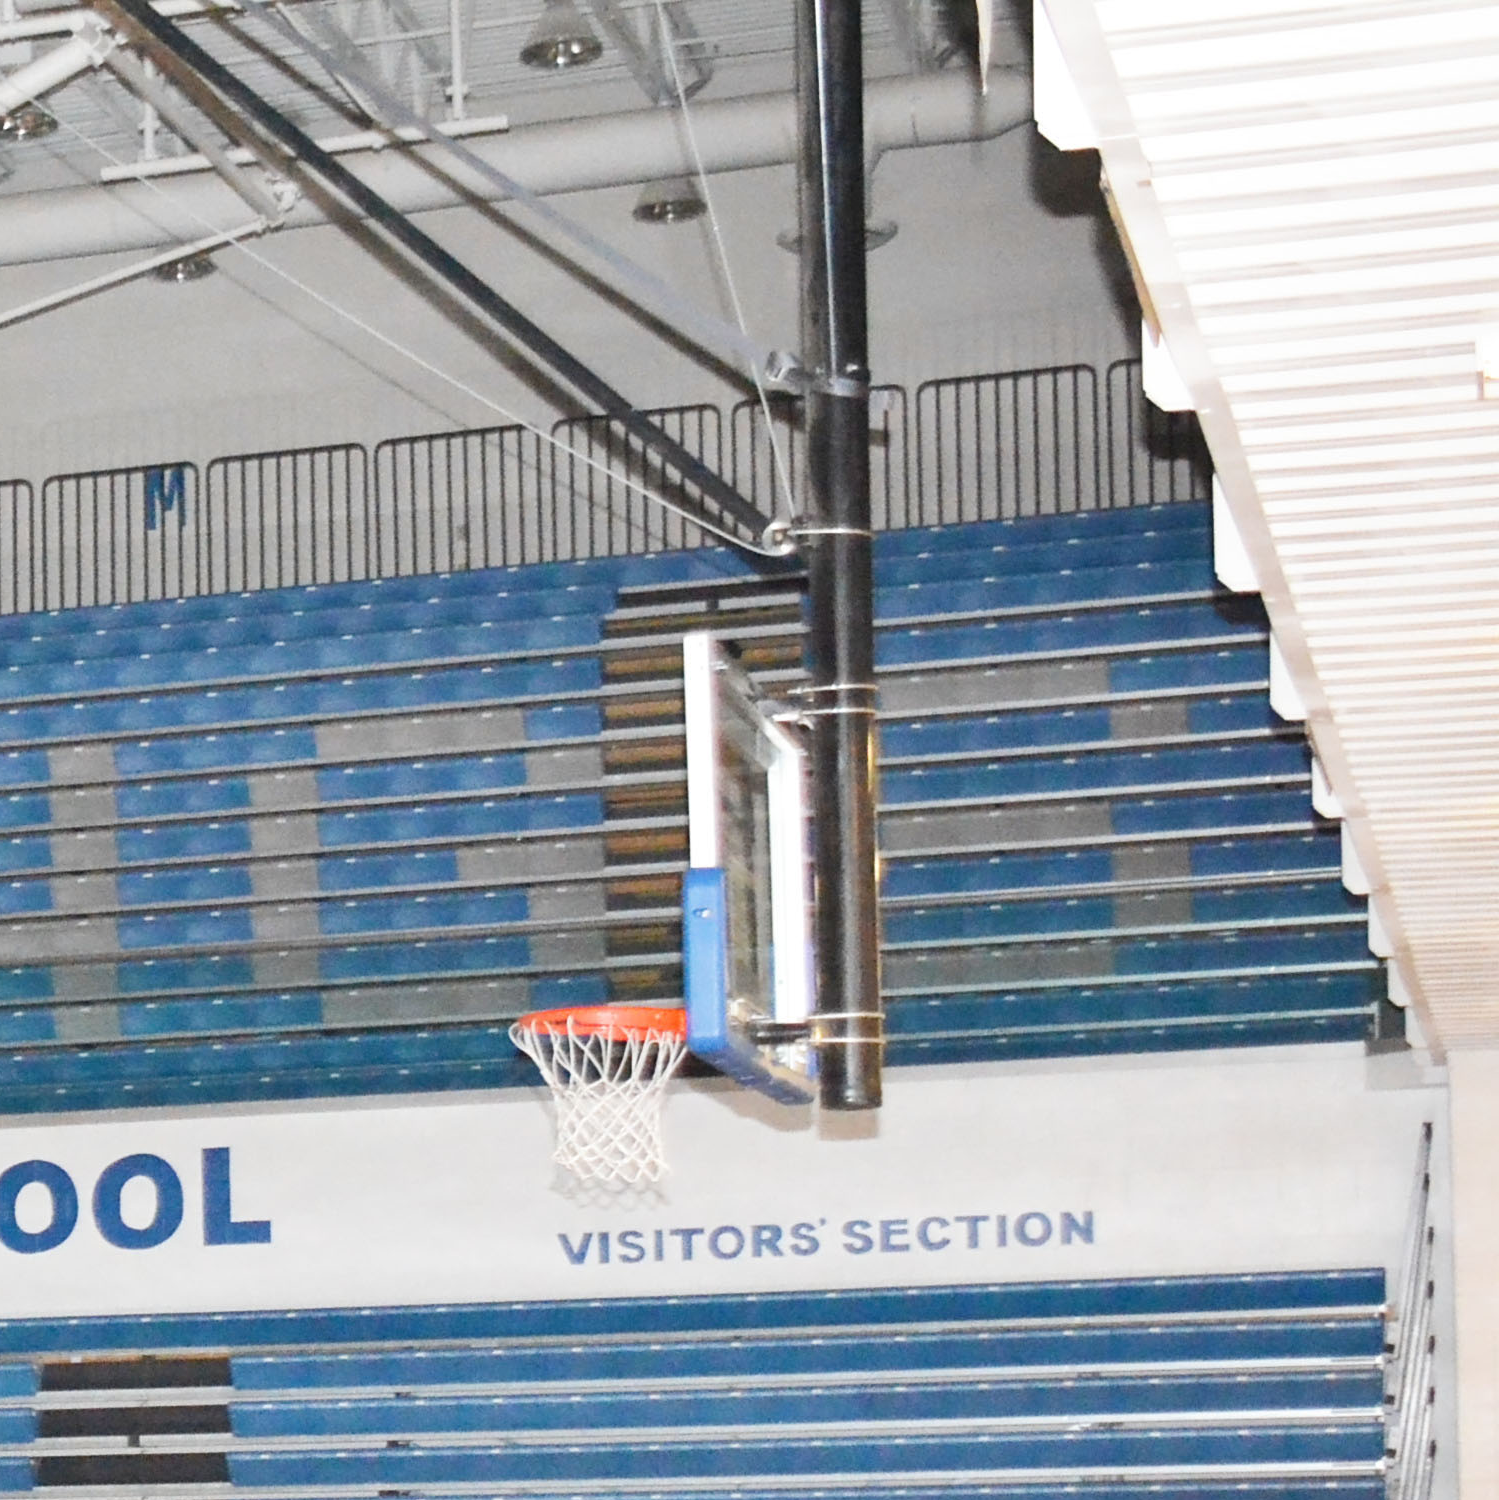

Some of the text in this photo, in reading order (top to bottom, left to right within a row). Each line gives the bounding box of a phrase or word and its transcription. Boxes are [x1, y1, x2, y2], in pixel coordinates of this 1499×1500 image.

[144, 464, 187, 531] M
[558, 1211, 1096, 1265] VISITORS' SECTION
